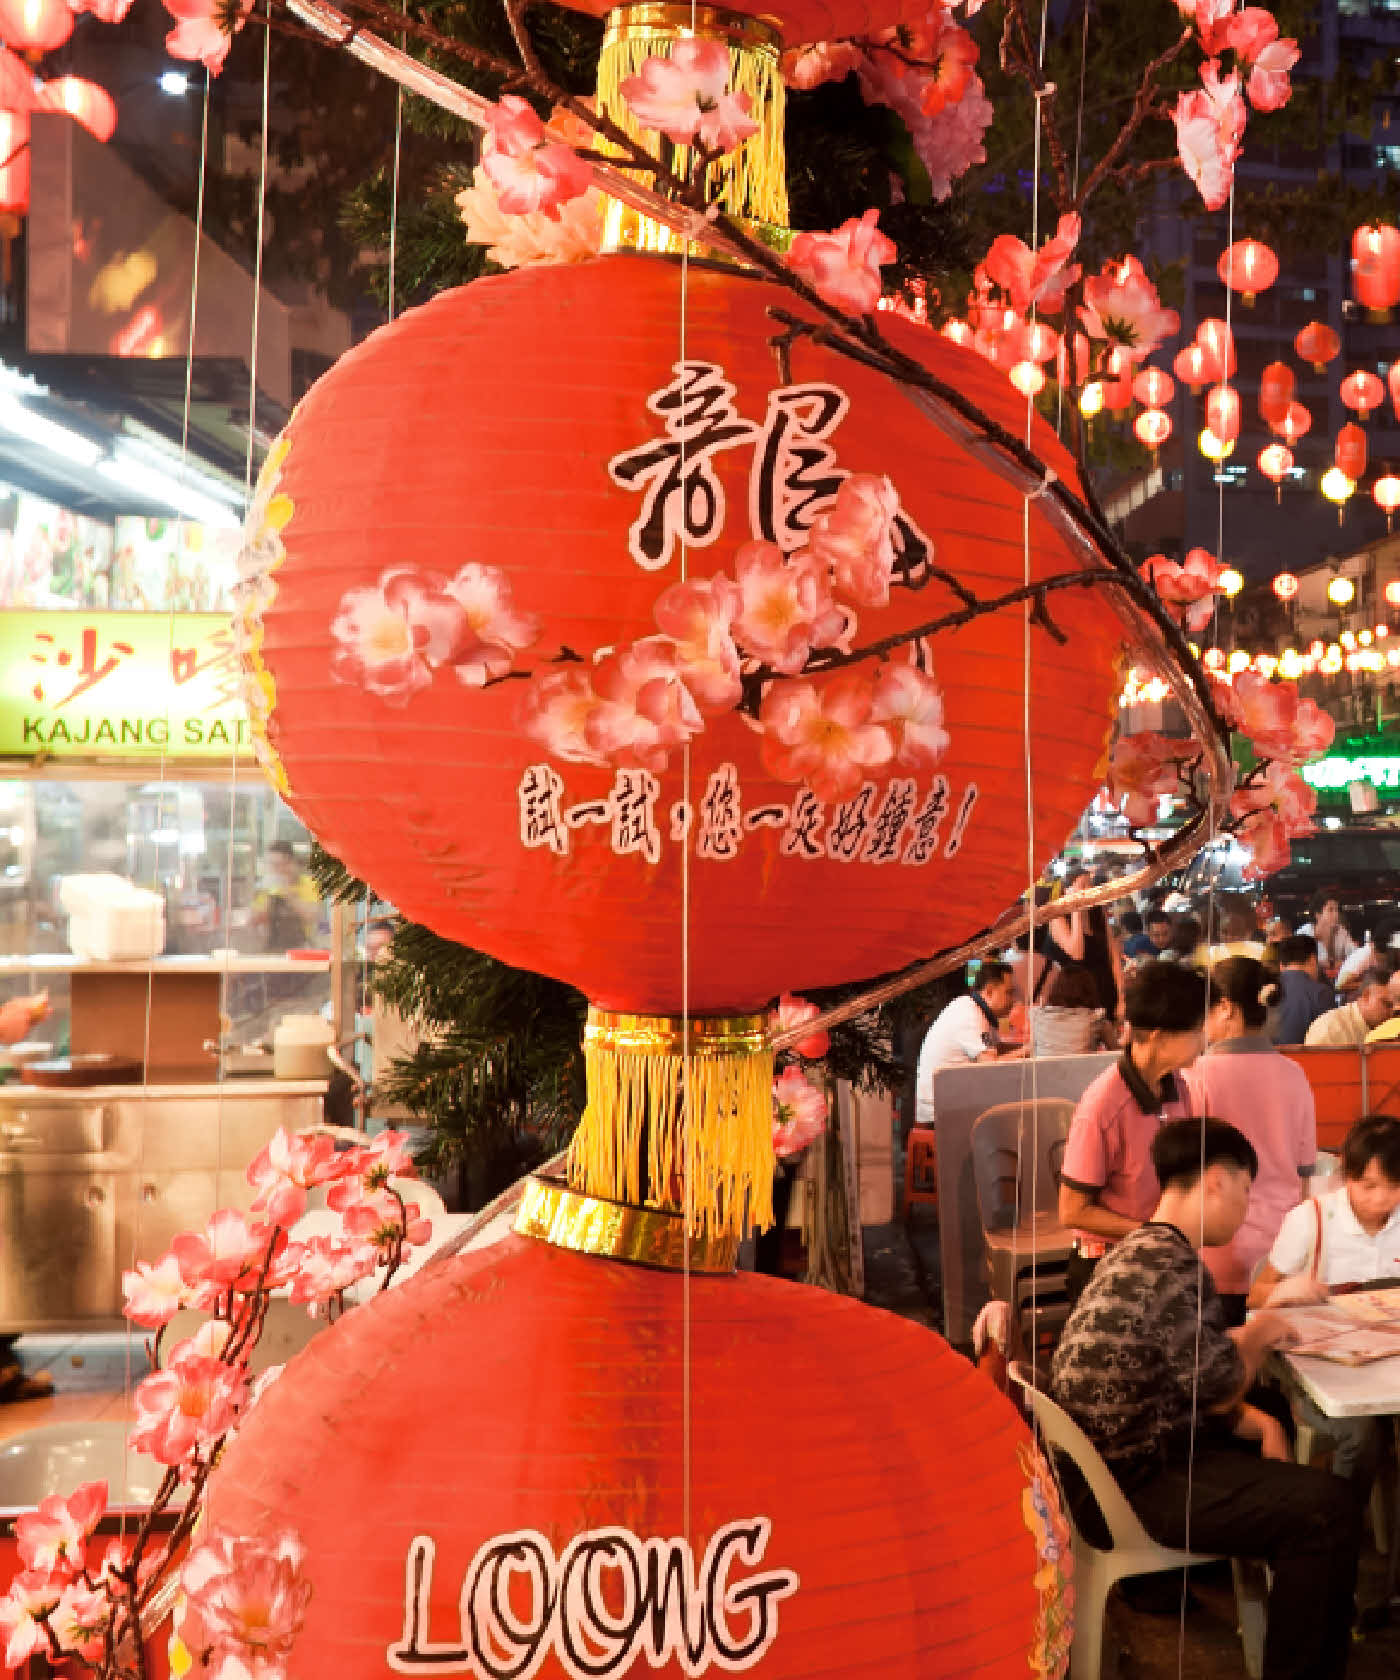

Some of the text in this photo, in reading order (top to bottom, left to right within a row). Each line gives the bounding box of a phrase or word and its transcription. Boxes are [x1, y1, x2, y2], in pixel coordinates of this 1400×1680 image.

[22, 717, 253, 744] KAJANG SAT
[387, 1517, 800, 1680] LOONG
